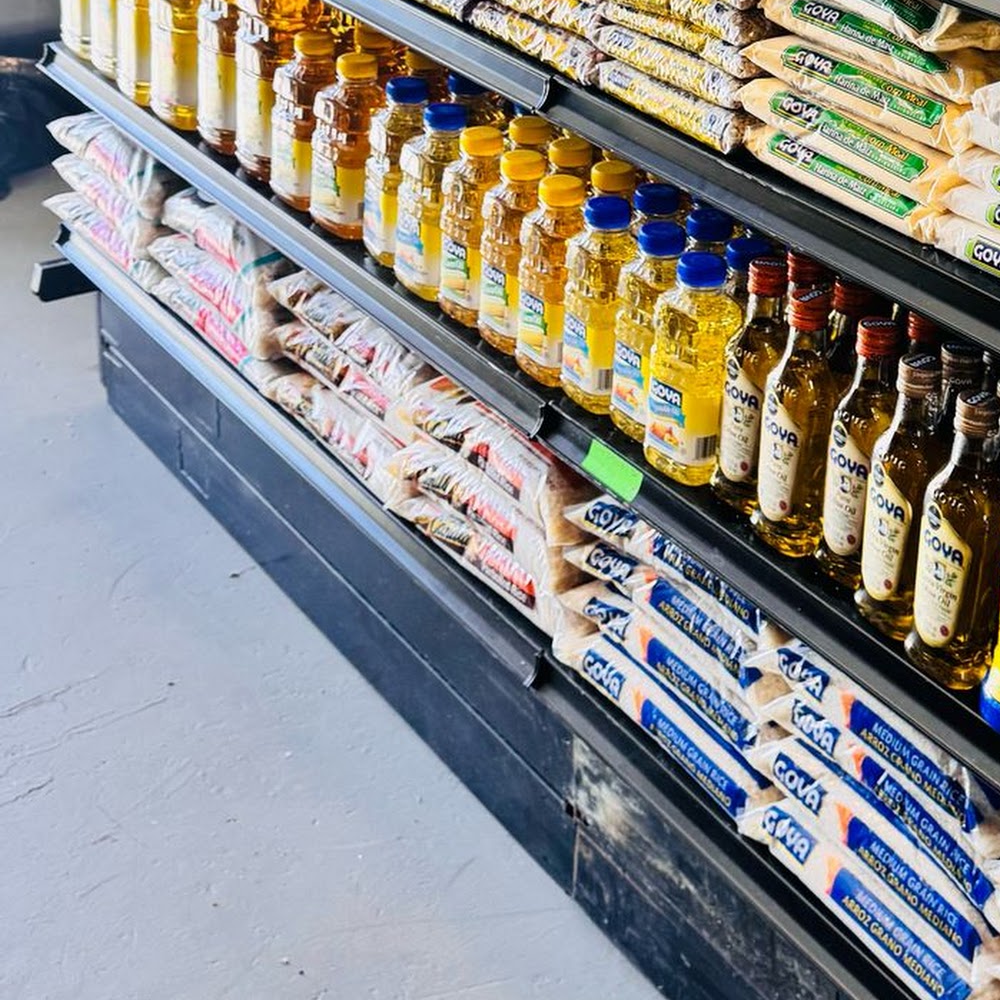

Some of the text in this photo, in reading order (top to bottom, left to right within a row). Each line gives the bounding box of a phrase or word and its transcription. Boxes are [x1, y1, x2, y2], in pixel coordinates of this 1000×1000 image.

[804, 2, 840, 24] GOYA
[794, 51, 832, 75] GOYA
[782, 97, 819, 121] GOYA
[905, 91, 927, 106] Meal
[725, 380, 759, 408] GOYA
[925, 530, 964, 564] GOYA
[872, 722, 940, 784] MEDIUM GRAIN
[871, 841, 958, 928] MEDIUM GRAIN RICE
[843, 896, 945, 997] ARROZ GRANO MEDIANO
